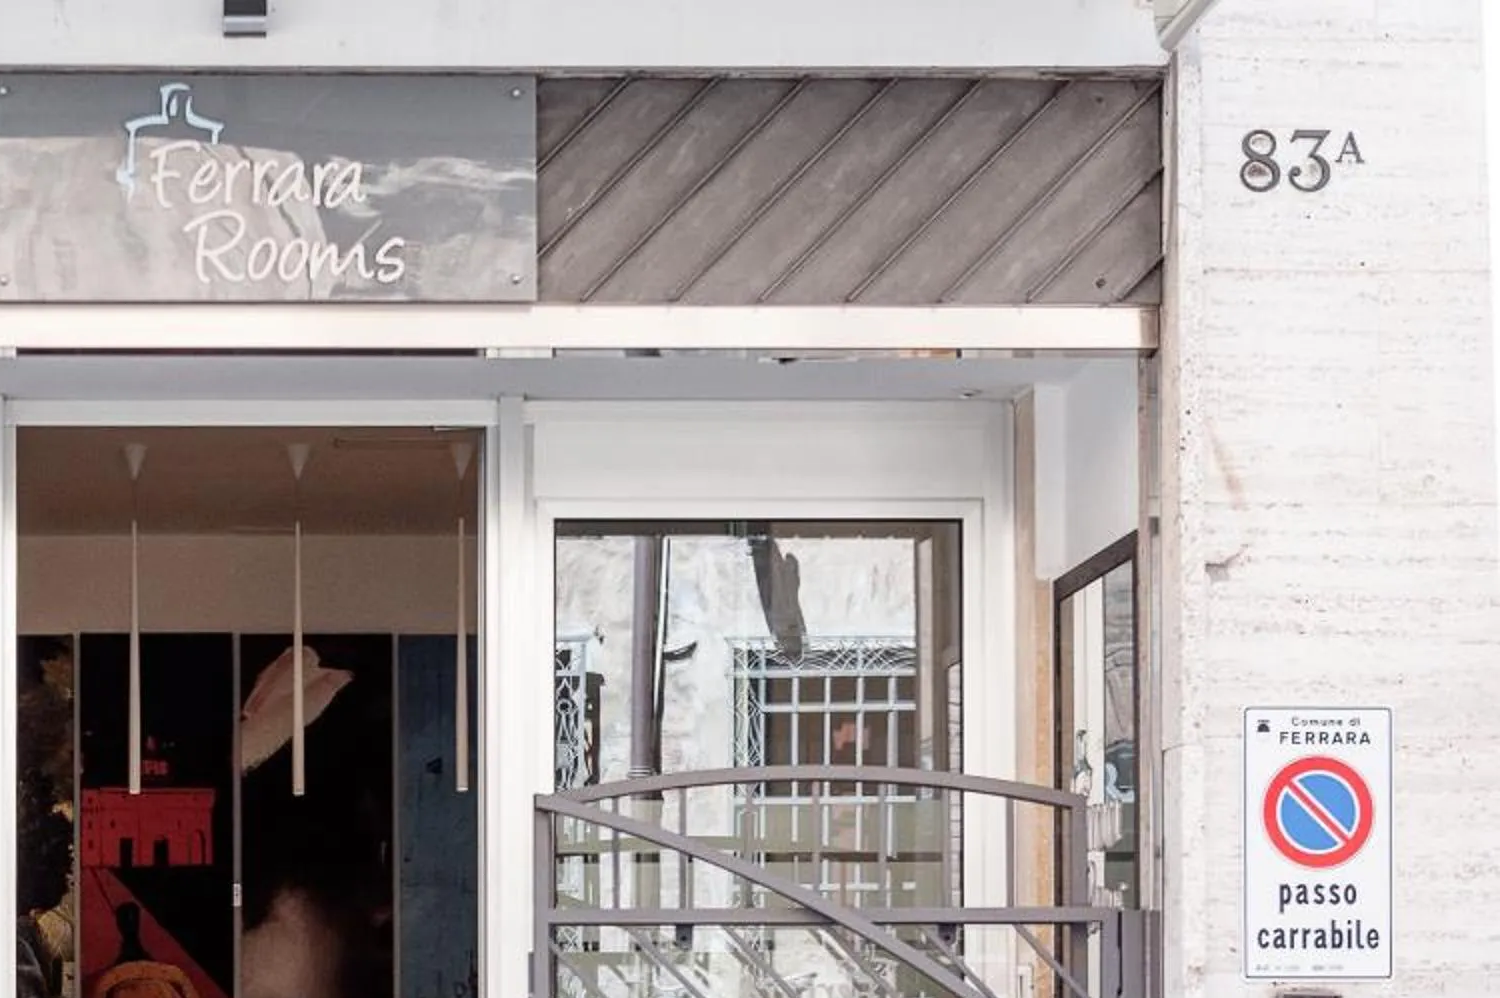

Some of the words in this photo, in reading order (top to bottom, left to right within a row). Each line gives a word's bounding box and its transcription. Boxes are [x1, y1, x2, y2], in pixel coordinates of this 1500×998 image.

[149, 139, 367, 209] Ferrara
[183, 210, 406, 284] Rooms
[1291, 716, 1343, 727] Comune
[1348, 716, 1361, 727] di
[1279, 731, 1371, 745] FERRARA
[1279, 883, 1357, 914] passo
[1257, 920, 1380, 950] carrabile
